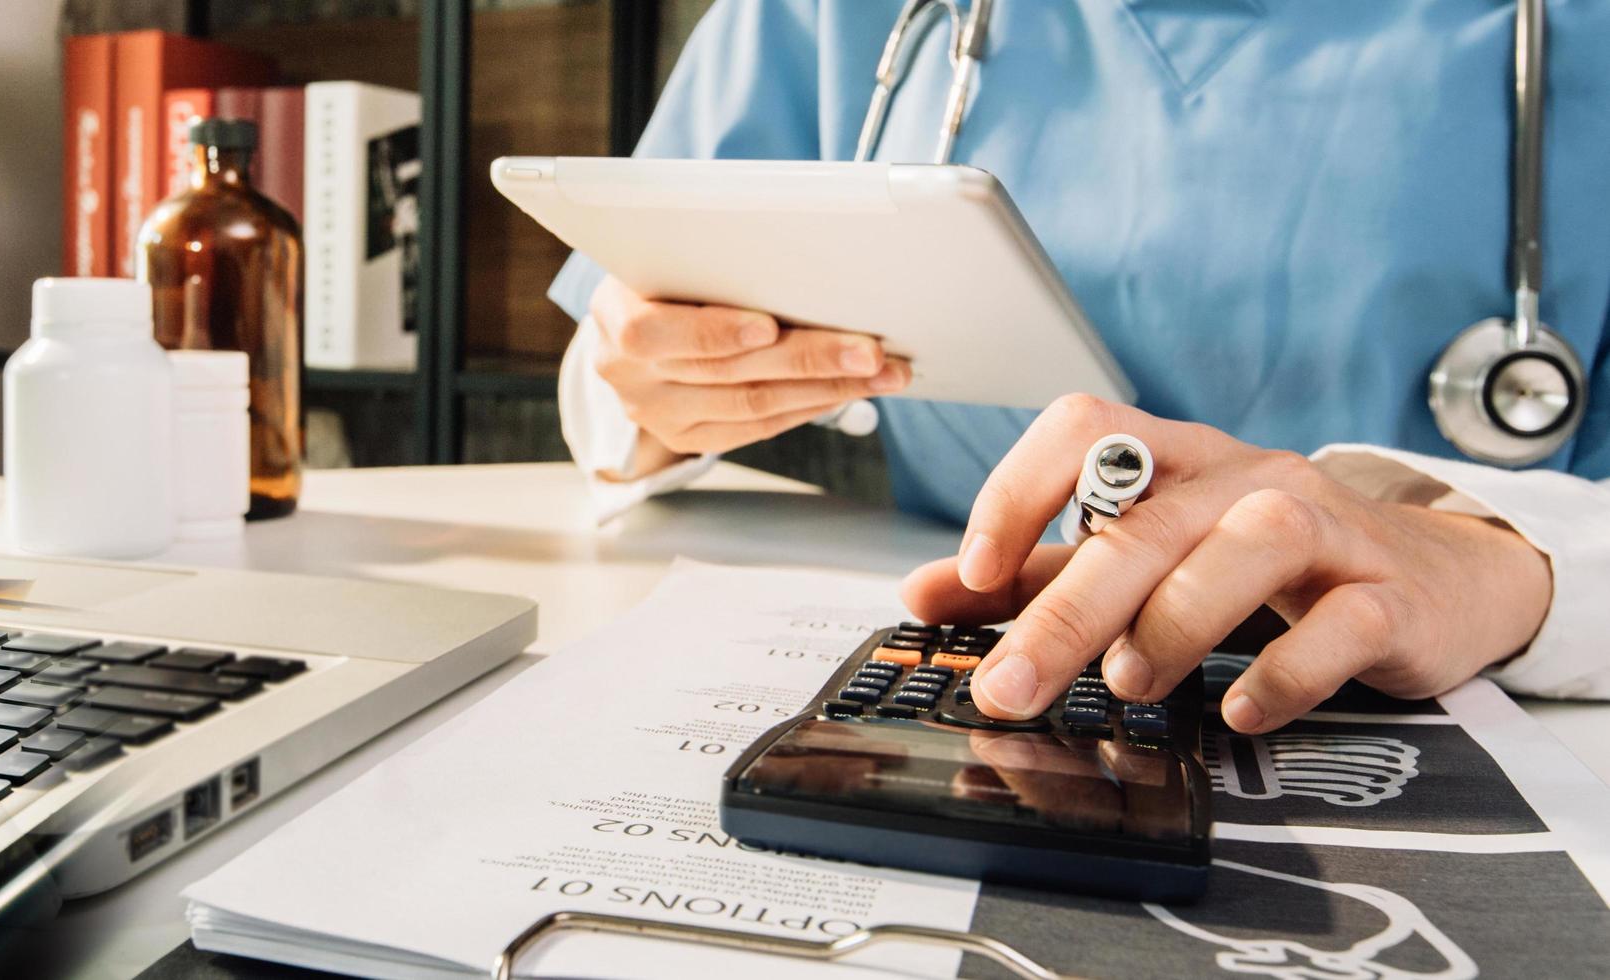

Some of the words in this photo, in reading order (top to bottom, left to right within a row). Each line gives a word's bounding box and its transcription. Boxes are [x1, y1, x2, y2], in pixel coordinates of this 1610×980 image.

[713, 700, 760, 713] 02
[678, 740, 726, 755] 01
[621, 791, 647, 799] this
[616, 811, 641, 819] the
[592, 818, 654, 837] 02
[562, 845, 591, 854] this
[553, 867, 581, 875] the
[530, 876, 594, 897] 01
[607, 886, 861, 937] OPTIONS
